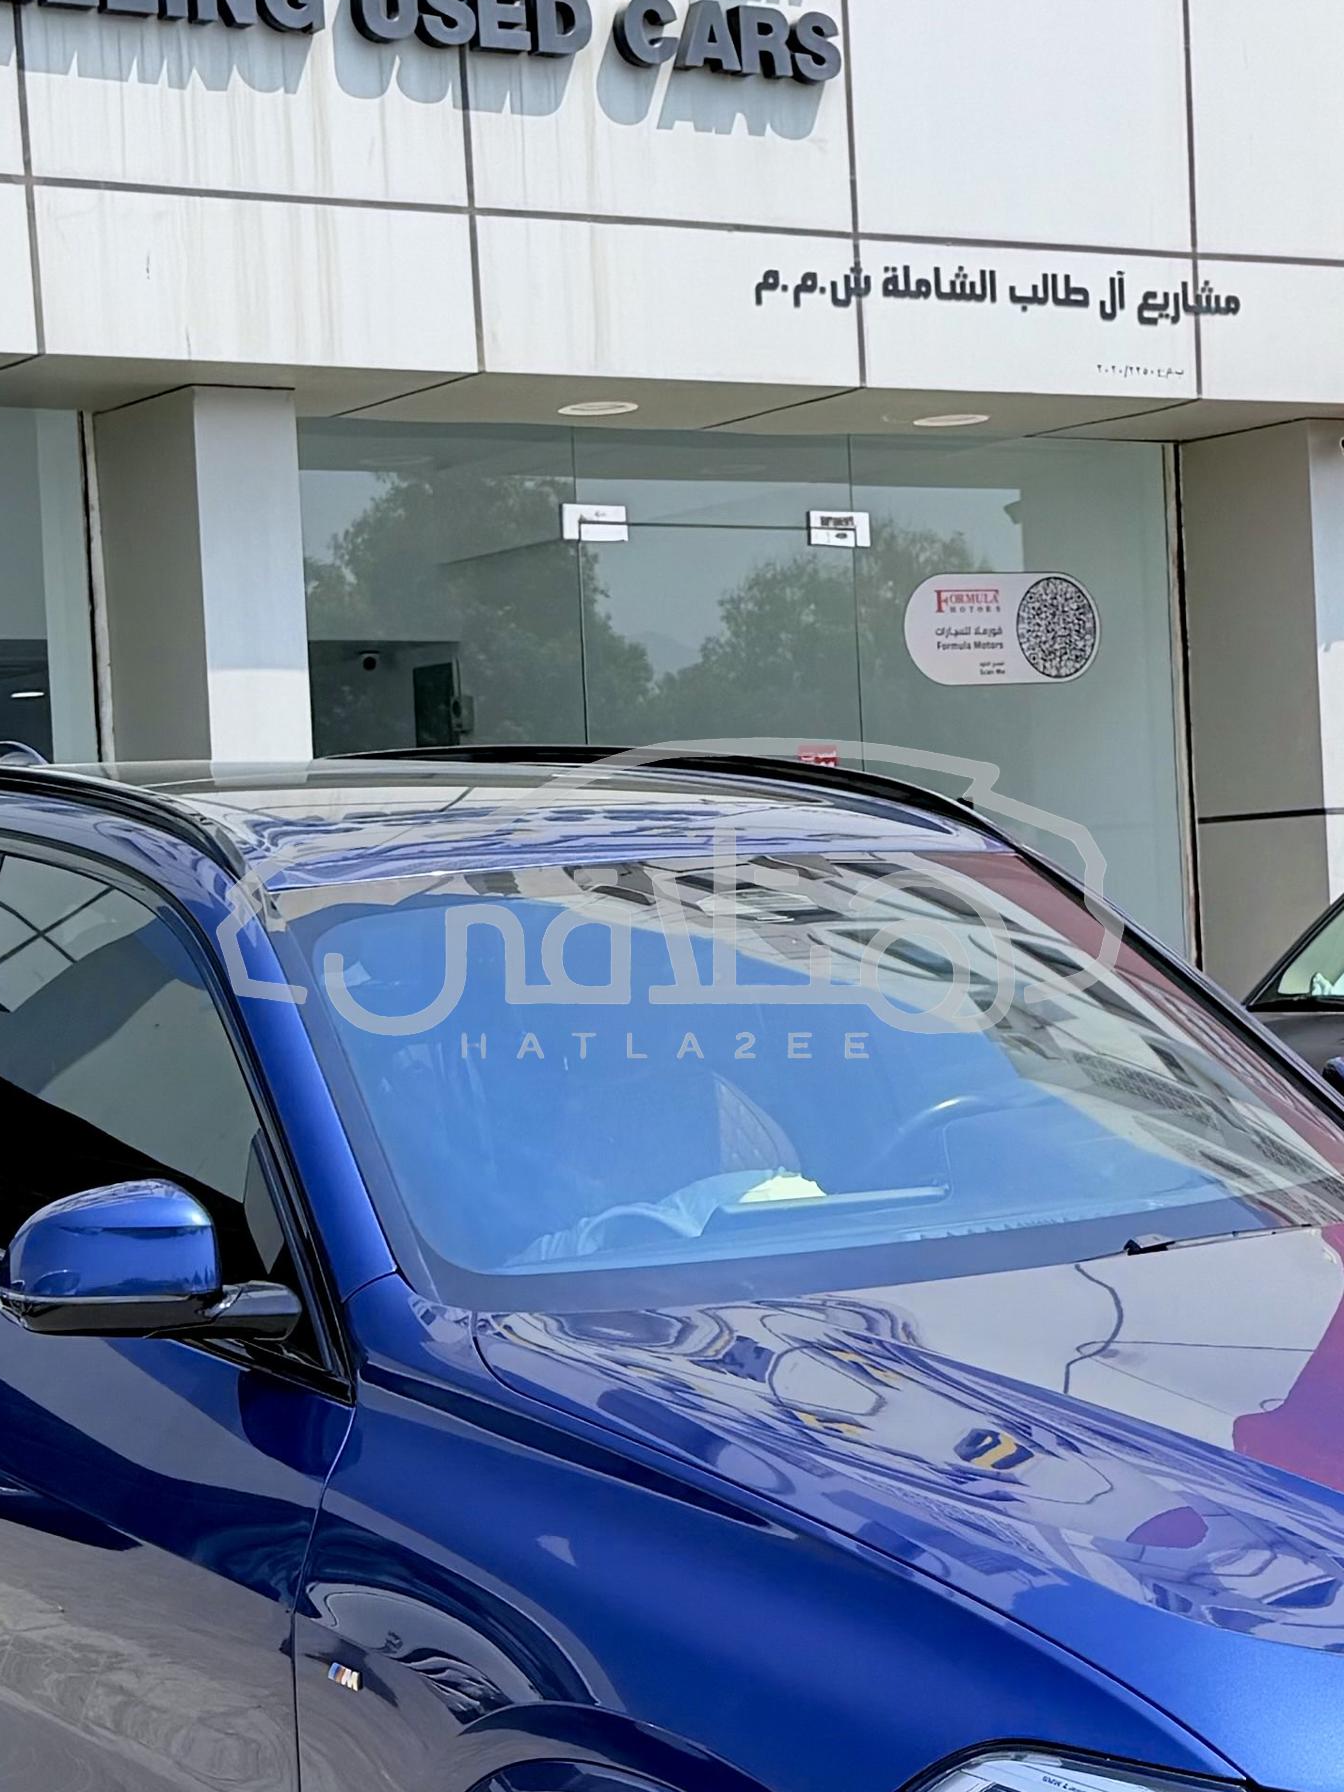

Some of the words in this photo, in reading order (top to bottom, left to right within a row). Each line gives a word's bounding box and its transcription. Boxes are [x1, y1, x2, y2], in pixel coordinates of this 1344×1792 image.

[881, 265, 996, 305] الشاملة
[1009, 273, 1089, 312] طالب
[1136, 278, 1241, 326] مشاريع
[935, 589, 999, 613] FORMULA
